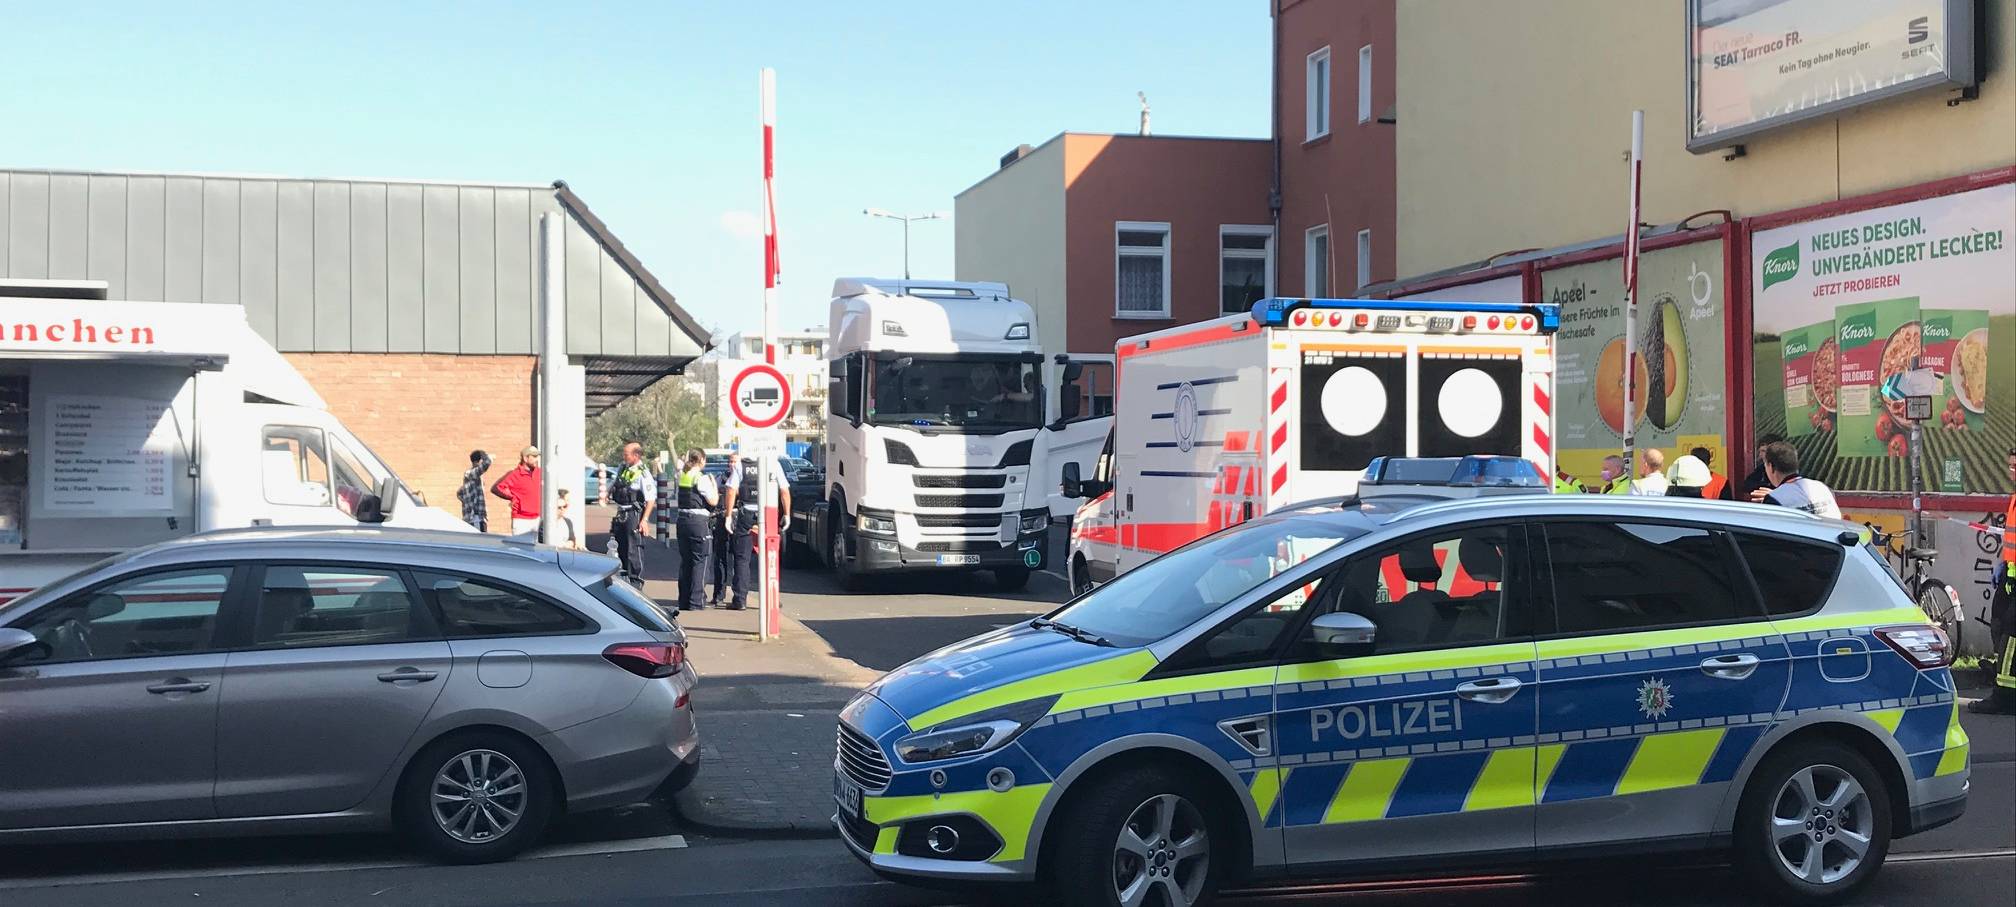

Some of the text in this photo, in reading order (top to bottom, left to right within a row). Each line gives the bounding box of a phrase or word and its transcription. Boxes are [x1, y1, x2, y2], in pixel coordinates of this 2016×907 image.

[1713, 31, 1802, 69] SEAT Tarraco FR.
[1779, 41, 1871, 75] Kein Tag ohne Neugier.
[1902, 43, 1935, 59] SEAT
[1811, 217, 1926, 253] NEUES DESIGN.
[1812, 230, 2003, 277] UNVERÄNDERT LECKER!
[1764, 256, 1798, 275] Knorr
[1552, 282, 1586, 309] Apeel
[1812, 274, 1900, 298] JETZT PROBIEREN
[1580, 306, 1608, 320] Früchte
[1610, 304, 1620, 317] im
[1690, 304, 1714, 321] Apeel
[1840, 323, 1875, 341] Knorr
[1922, 323, 1950, 337] Knorr
[1785, 343, 1808, 356] Knorr
[1310, 699, 1463, 742] POLIZEI
